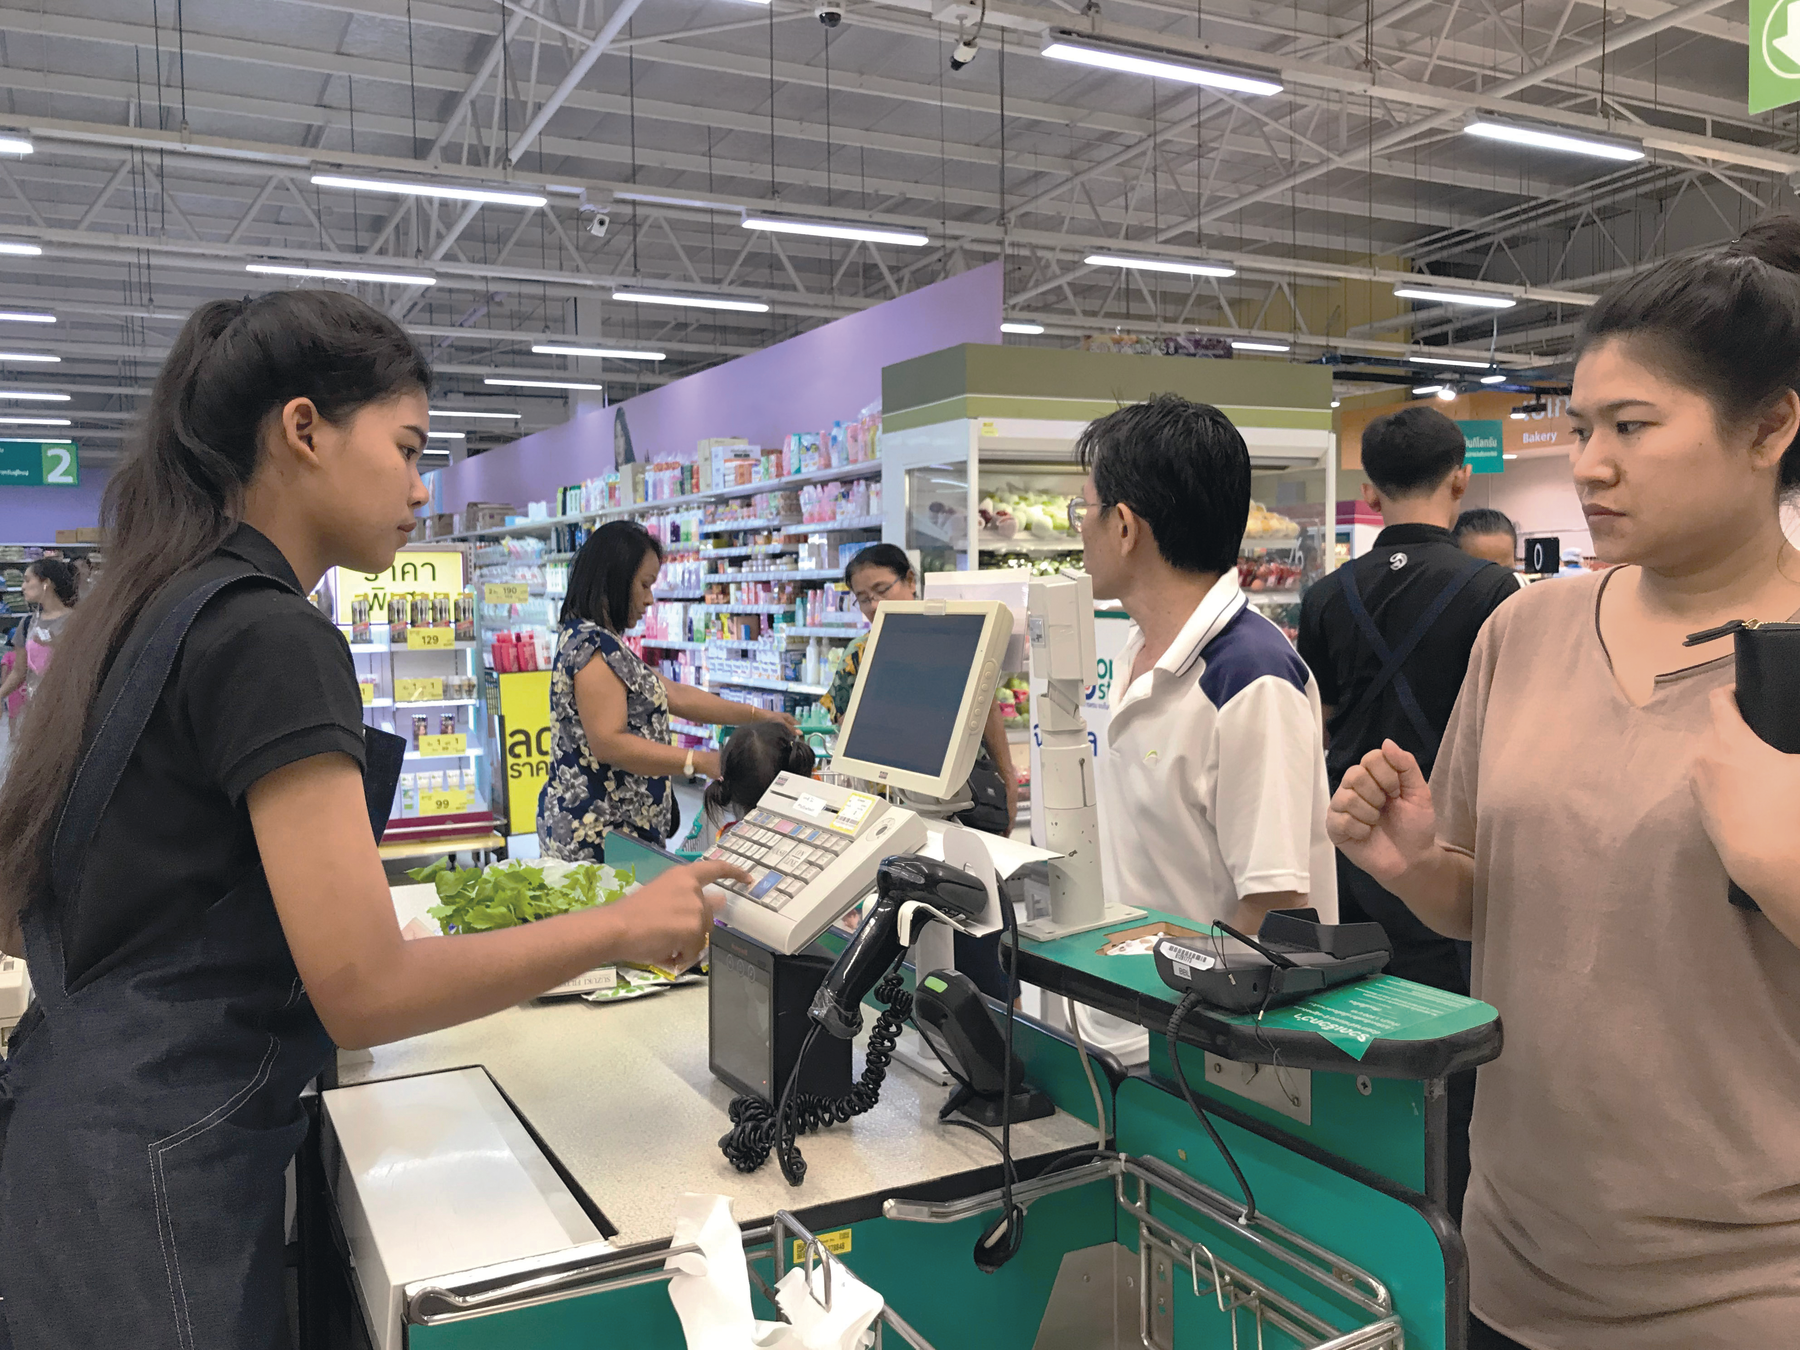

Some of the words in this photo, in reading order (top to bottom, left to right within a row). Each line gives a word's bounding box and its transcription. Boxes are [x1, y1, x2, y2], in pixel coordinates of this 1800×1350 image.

[1523, 431, 1557, 443] Bakery
[47, 448, 73, 482] 2
[1533, 542, 1543, 571] 0
[502, 587, 517, 595] 190
[421, 635, 439, 645] 129
[435, 799, 450, 810] 99
[583, 976, 611, 986] SUZUKI
